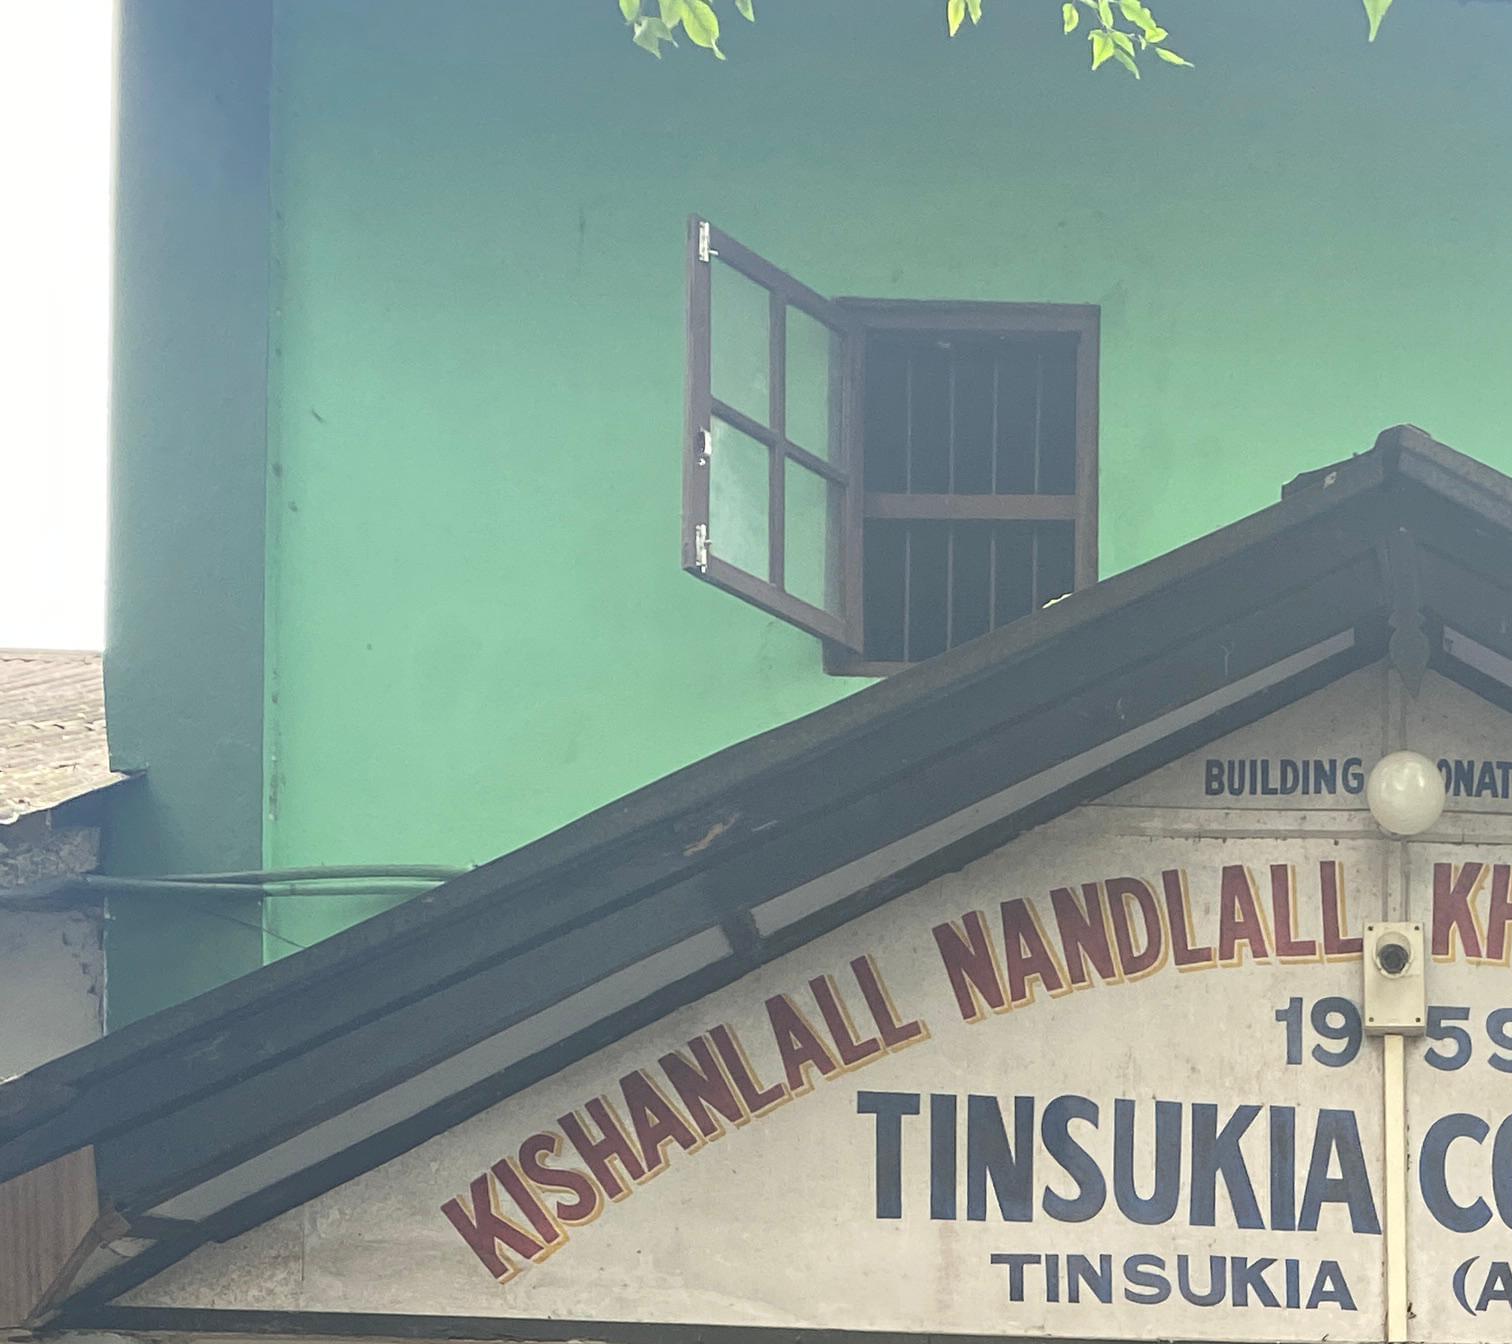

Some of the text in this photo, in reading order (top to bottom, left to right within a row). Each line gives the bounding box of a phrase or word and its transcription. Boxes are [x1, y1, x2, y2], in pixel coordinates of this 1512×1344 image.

[1204, 756, 1365, 797] BUILDING
[439, 953, 931, 1285] KISHANLALL
[931, 860, 1365, 1025] NANDLALL
[855, 1090, 1382, 1236] TINSUKIA
[990, 1252, 1358, 1312] TINSUKIA
